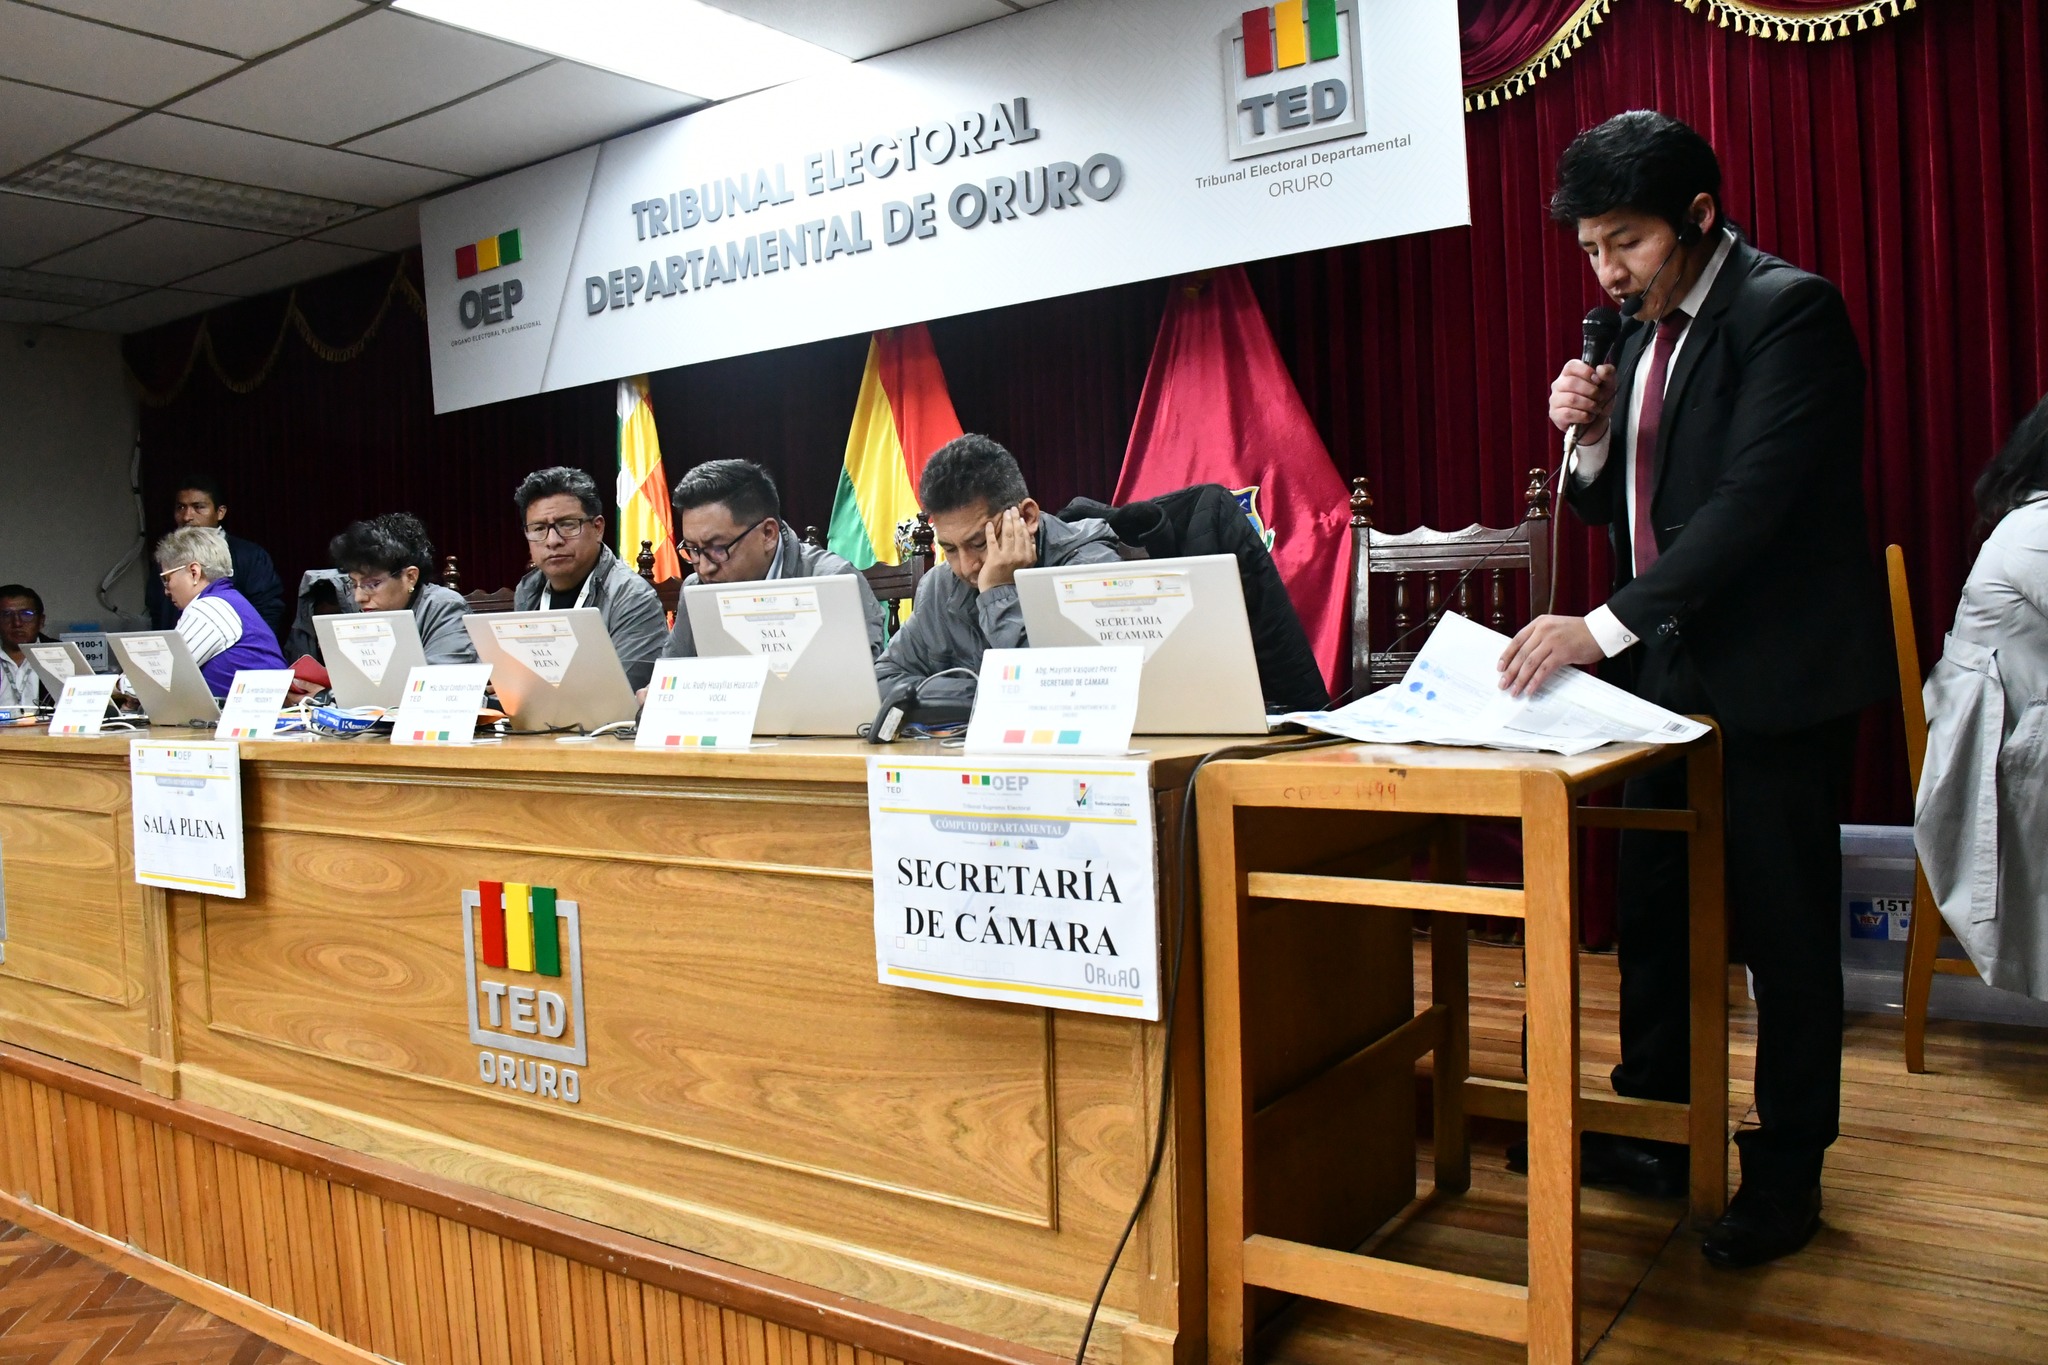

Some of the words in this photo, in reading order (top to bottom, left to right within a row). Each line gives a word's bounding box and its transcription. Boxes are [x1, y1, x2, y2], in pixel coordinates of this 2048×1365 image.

[1236, 78, 1348, 136] TED
[631, 162, 795, 241] TRIBUNAL
[804, 96, 1040, 196] ELECTORAL
[1195, 168, 1247, 190] Tribunal
[1249, 155, 1308, 178] Electoral
[1311, 134, 1412, 167] Departamental
[1268, 171, 1334, 198] ORURO
[584, 208, 872, 317] DEPARTAMENTAL
[882, 192, 937, 246] DE
[947, 152, 1123, 230] ORURO
[458, 278, 525, 330] OEP
[471, 330, 501, 343] ELECTORAL
[501, 320, 542, 335] PLURINACIONAL
[760, 628, 787, 639] SALA
[1099, 632, 1114, 641] DE
[530, 648, 552, 657] SALA
[760, 643, 793, 653] PLENA
[533, 659, 560, 668] PLENA
[1001, 684, 1020, 694] TED
[1040, 678, 1074, 687] SECRETARIO
[1075, 678, 1083, 686] DE
[657, 693, 674, 702] TED
[708, 693, 727, 702] VOCAL
[886, 786, 902, 795] TED
[991, 775, 1030, 793] OEP
[143, 814, 177, 836] SALA
[180, 817, 225, 840] PLENA
[934, 817, 980, 832] CÓMPUTO
[980, 820, 1065, 836] DEPARTAMENTAL
[896, 856, 1122, 904] SECRETARÍA
[1860, 915, 1879, 924] REY
[904, 906, 945, 939] DE
[955, 906, 1120, 957] CÁMARA
[480, 980, 568, 1039] TED
[479, 1050, 581, 1104] ORURO
